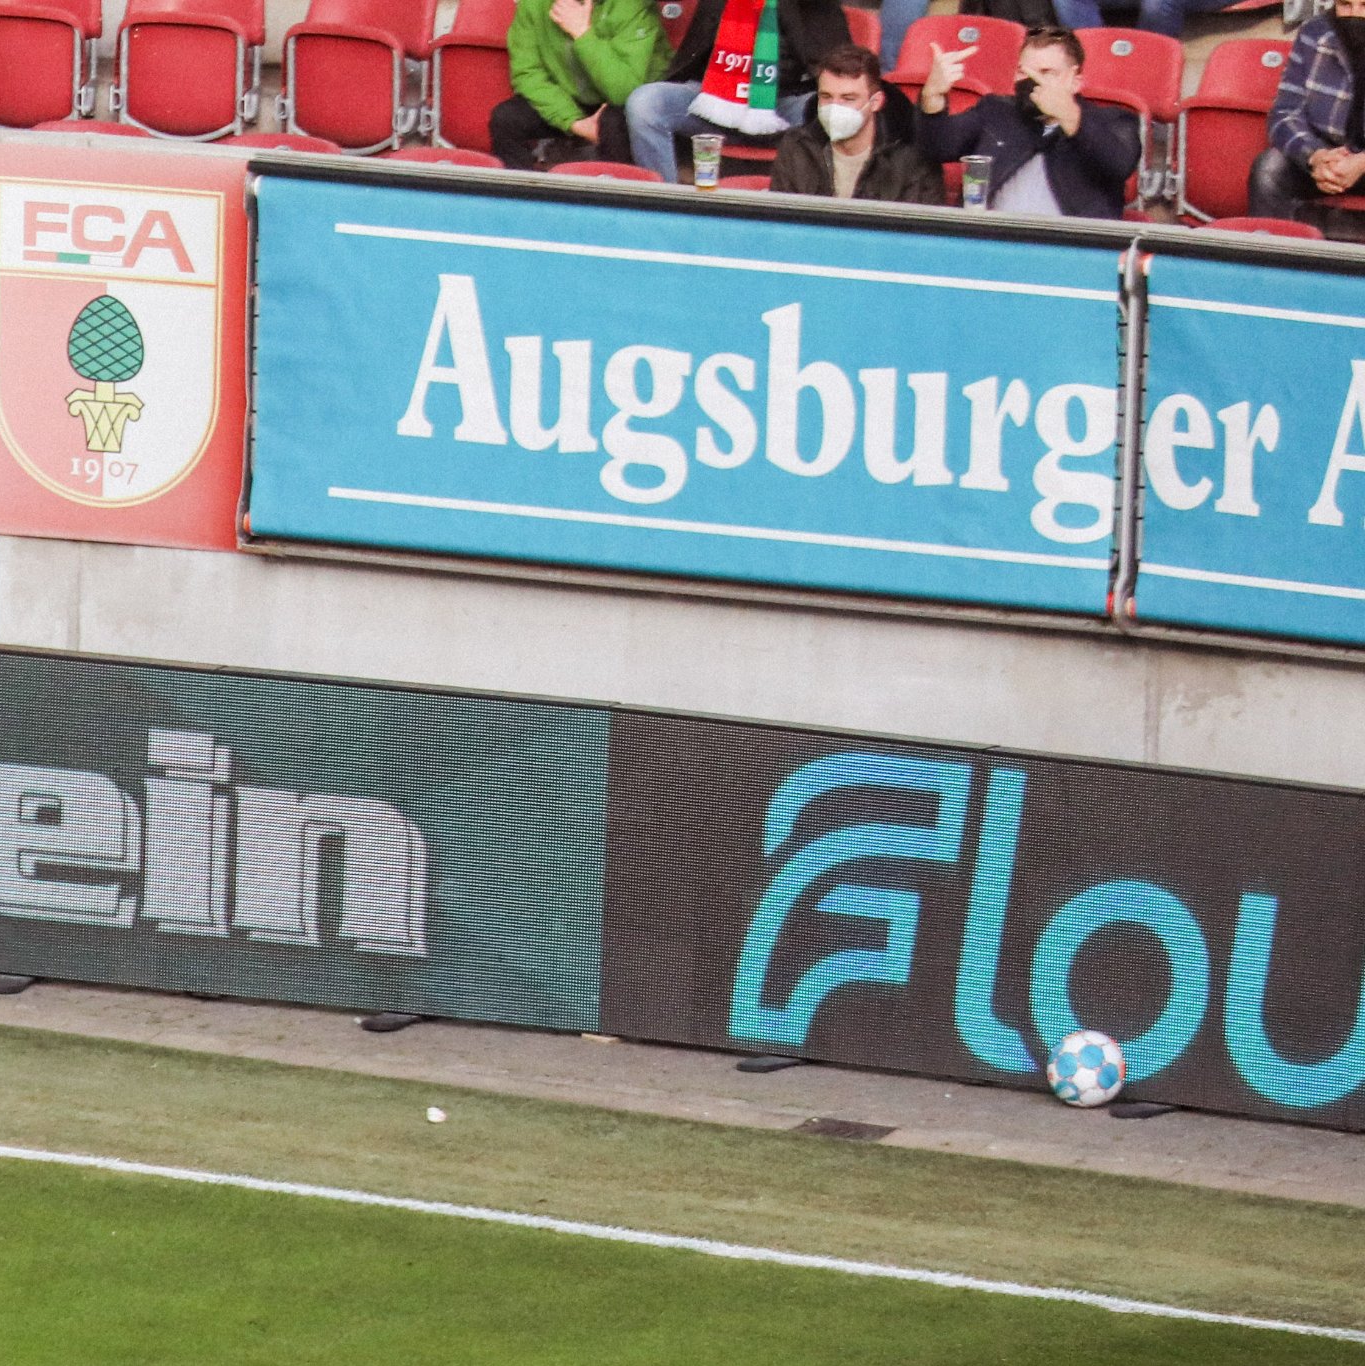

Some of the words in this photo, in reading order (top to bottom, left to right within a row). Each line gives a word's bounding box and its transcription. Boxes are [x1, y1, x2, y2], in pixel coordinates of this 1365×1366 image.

[22, 202, 195, 273] FCA
[397, 273, 1281, 545] Augsburger
[70, 456, 139, 485] 1907
